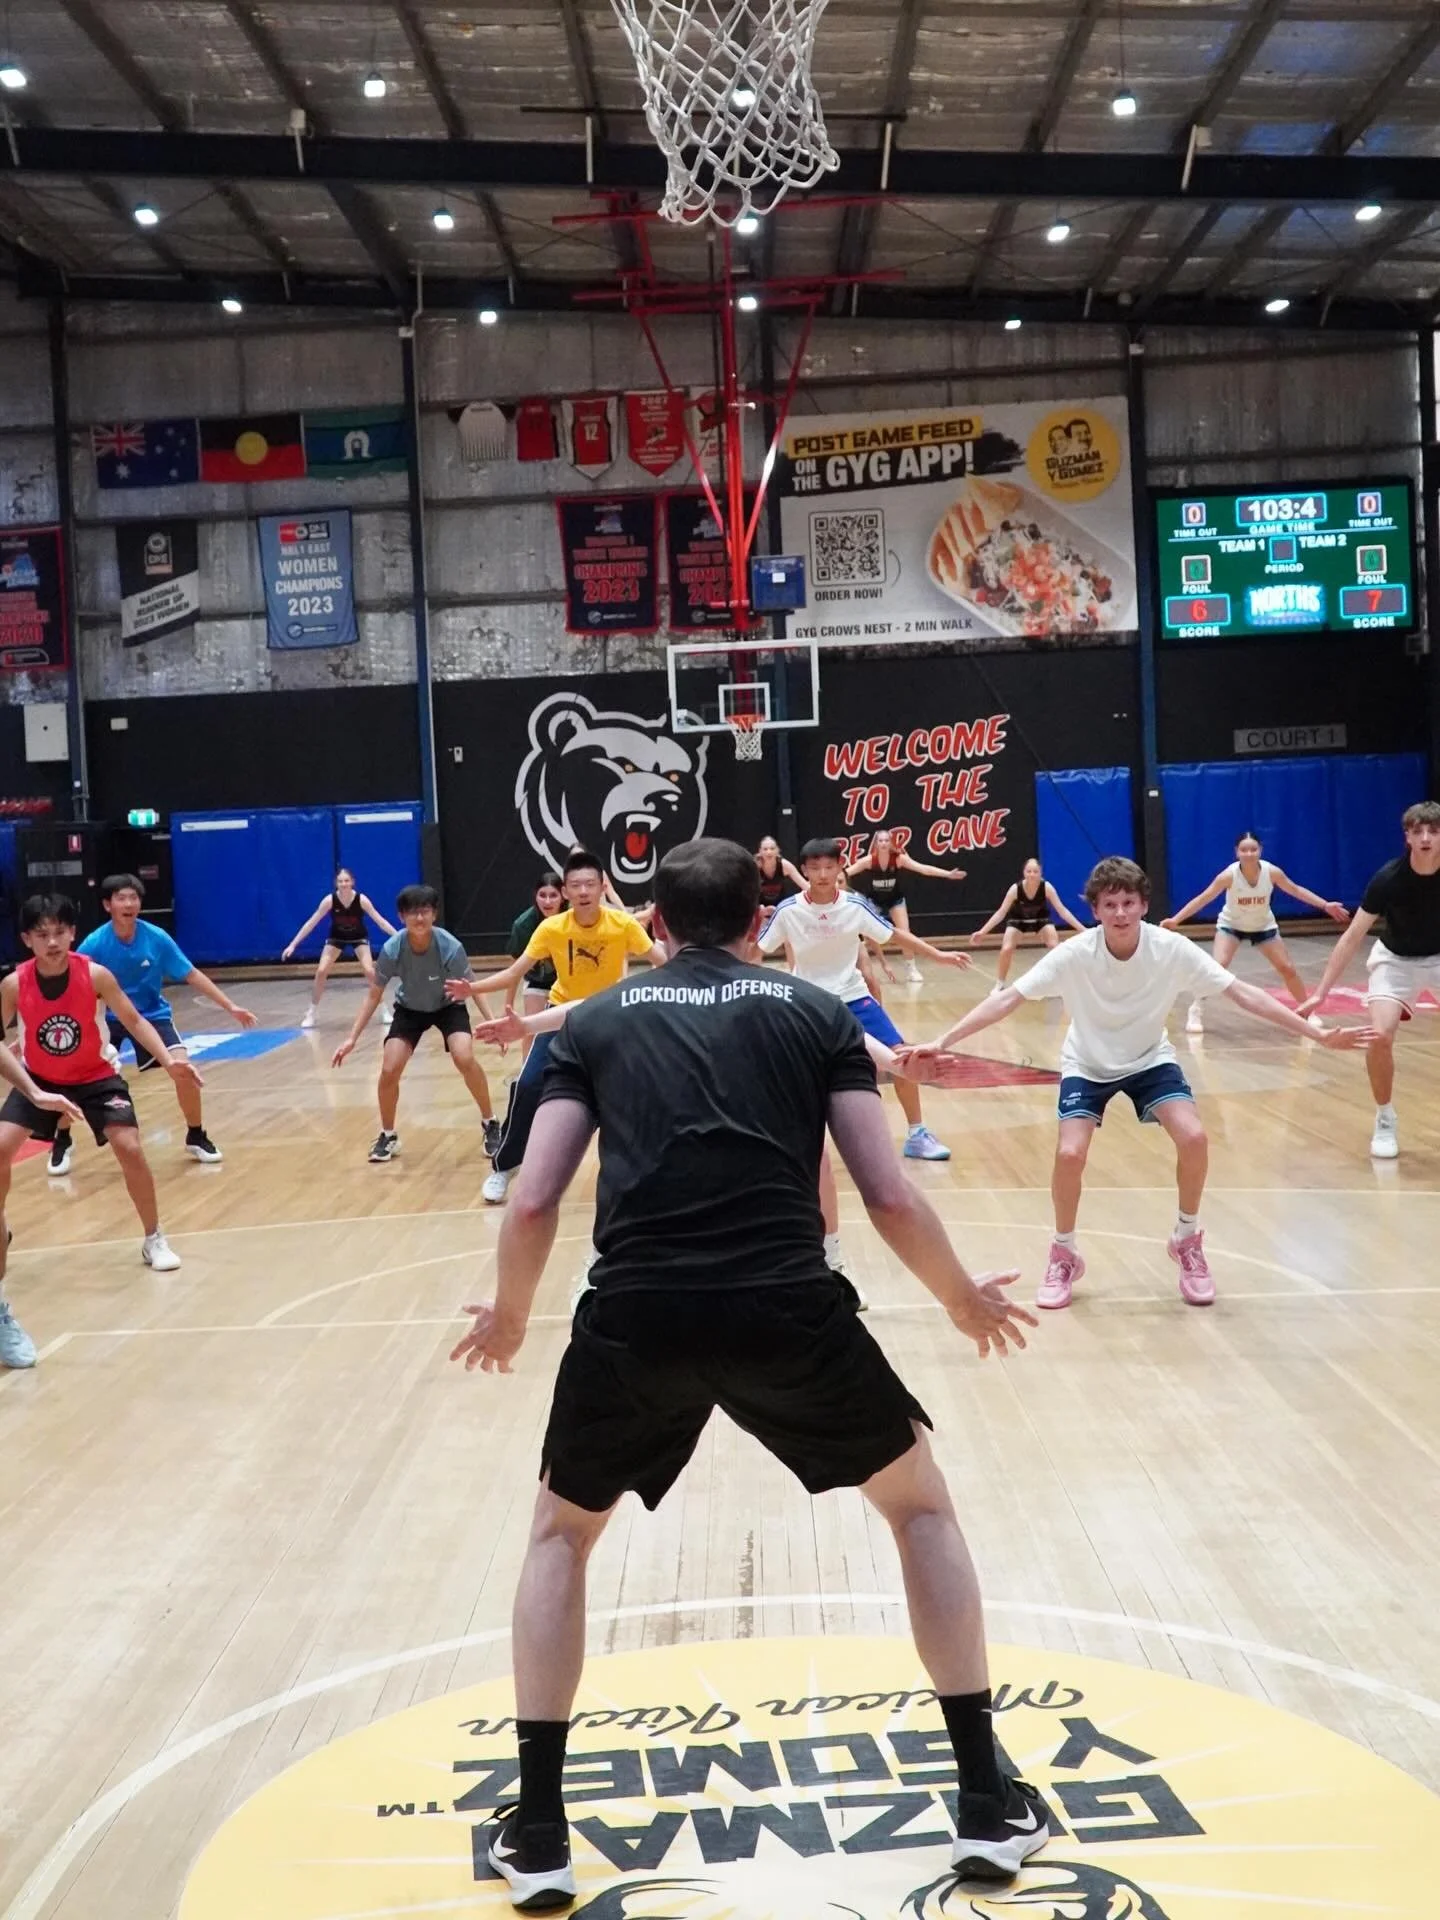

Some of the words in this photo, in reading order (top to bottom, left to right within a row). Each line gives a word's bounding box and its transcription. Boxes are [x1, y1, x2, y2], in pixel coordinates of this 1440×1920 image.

[794, 433, 848, 454] POST
[852, 425, 914, 448] GAME
[918, 419, 974, 441] FEED
[795, 457, 817, 475] ON
[826, 450, 891, 487] GYG
[897, 441, 974, 480] APP!
[792, 473, 822, 492] THE
[1047, 469, 1056, 482] Y
[1247, 497, 1317, 521] 103:4
[1363, 495, 1377, 513] 0
[1187, 505, 1202, 523] 0
[1348, 519, 1372, 528] TIME
[1373, 517, 1393, 526] OUT
[1173, 529, 1196, 538] TIME
[1198, 527, 1218, 536] OUT
[1249, 524, 1283, 535] GAME
[1286, 521, 1316, 532] TIME
[1218, 539, 1256, 553] TEAM
[1257, 538, 1265, 551] 1
[1299, 535, 1337, 548] TEAM
[1337, 533, 1347, 546] 2
[278, 556, 338, 577] WOMEN
[1264, 562, 1304, 574] PERIOD
[275, 575, 344, 595] CHAMPIONS
[1357, 574, 1387, 584] FOUL
[814, 588, 850, 601] ORDER
[854, 588, 883, 600] NOW!
[1182, 584, 1211, 595] FOUL
[287, 595, 334, 617] 2023
[1366, 588, 1383, 613] 7
[1190, 599, 1208, 622] 6
[795, 626, 817, 639] GYG
[820, 624, 861, 638] CROWS
[864, 622, 892, 635] NEST
[904, 621, 911, 633] 2
[915, 620, 937, 632] MIN
[941, 618, 973, 631] WALK
[1179, 625, 1220, 638] SCORE
[1353, 615, 1395, 629] SCORE
[824, 713, 1011, 780] WELCOME
[1247, 727, 1320, 748] COURT
[1327, 728, 1335, 744] 1
[842, 783, 890, 826] TO
[915, 763, 993, 812] THE
[927, 808, 1011, 856] CAVE
[621, 986, 715, 1007] LOCKDOWN
[721, 979, 795, 1003] DEFENSE
[1050, 1717, 1157, 1769] Y
